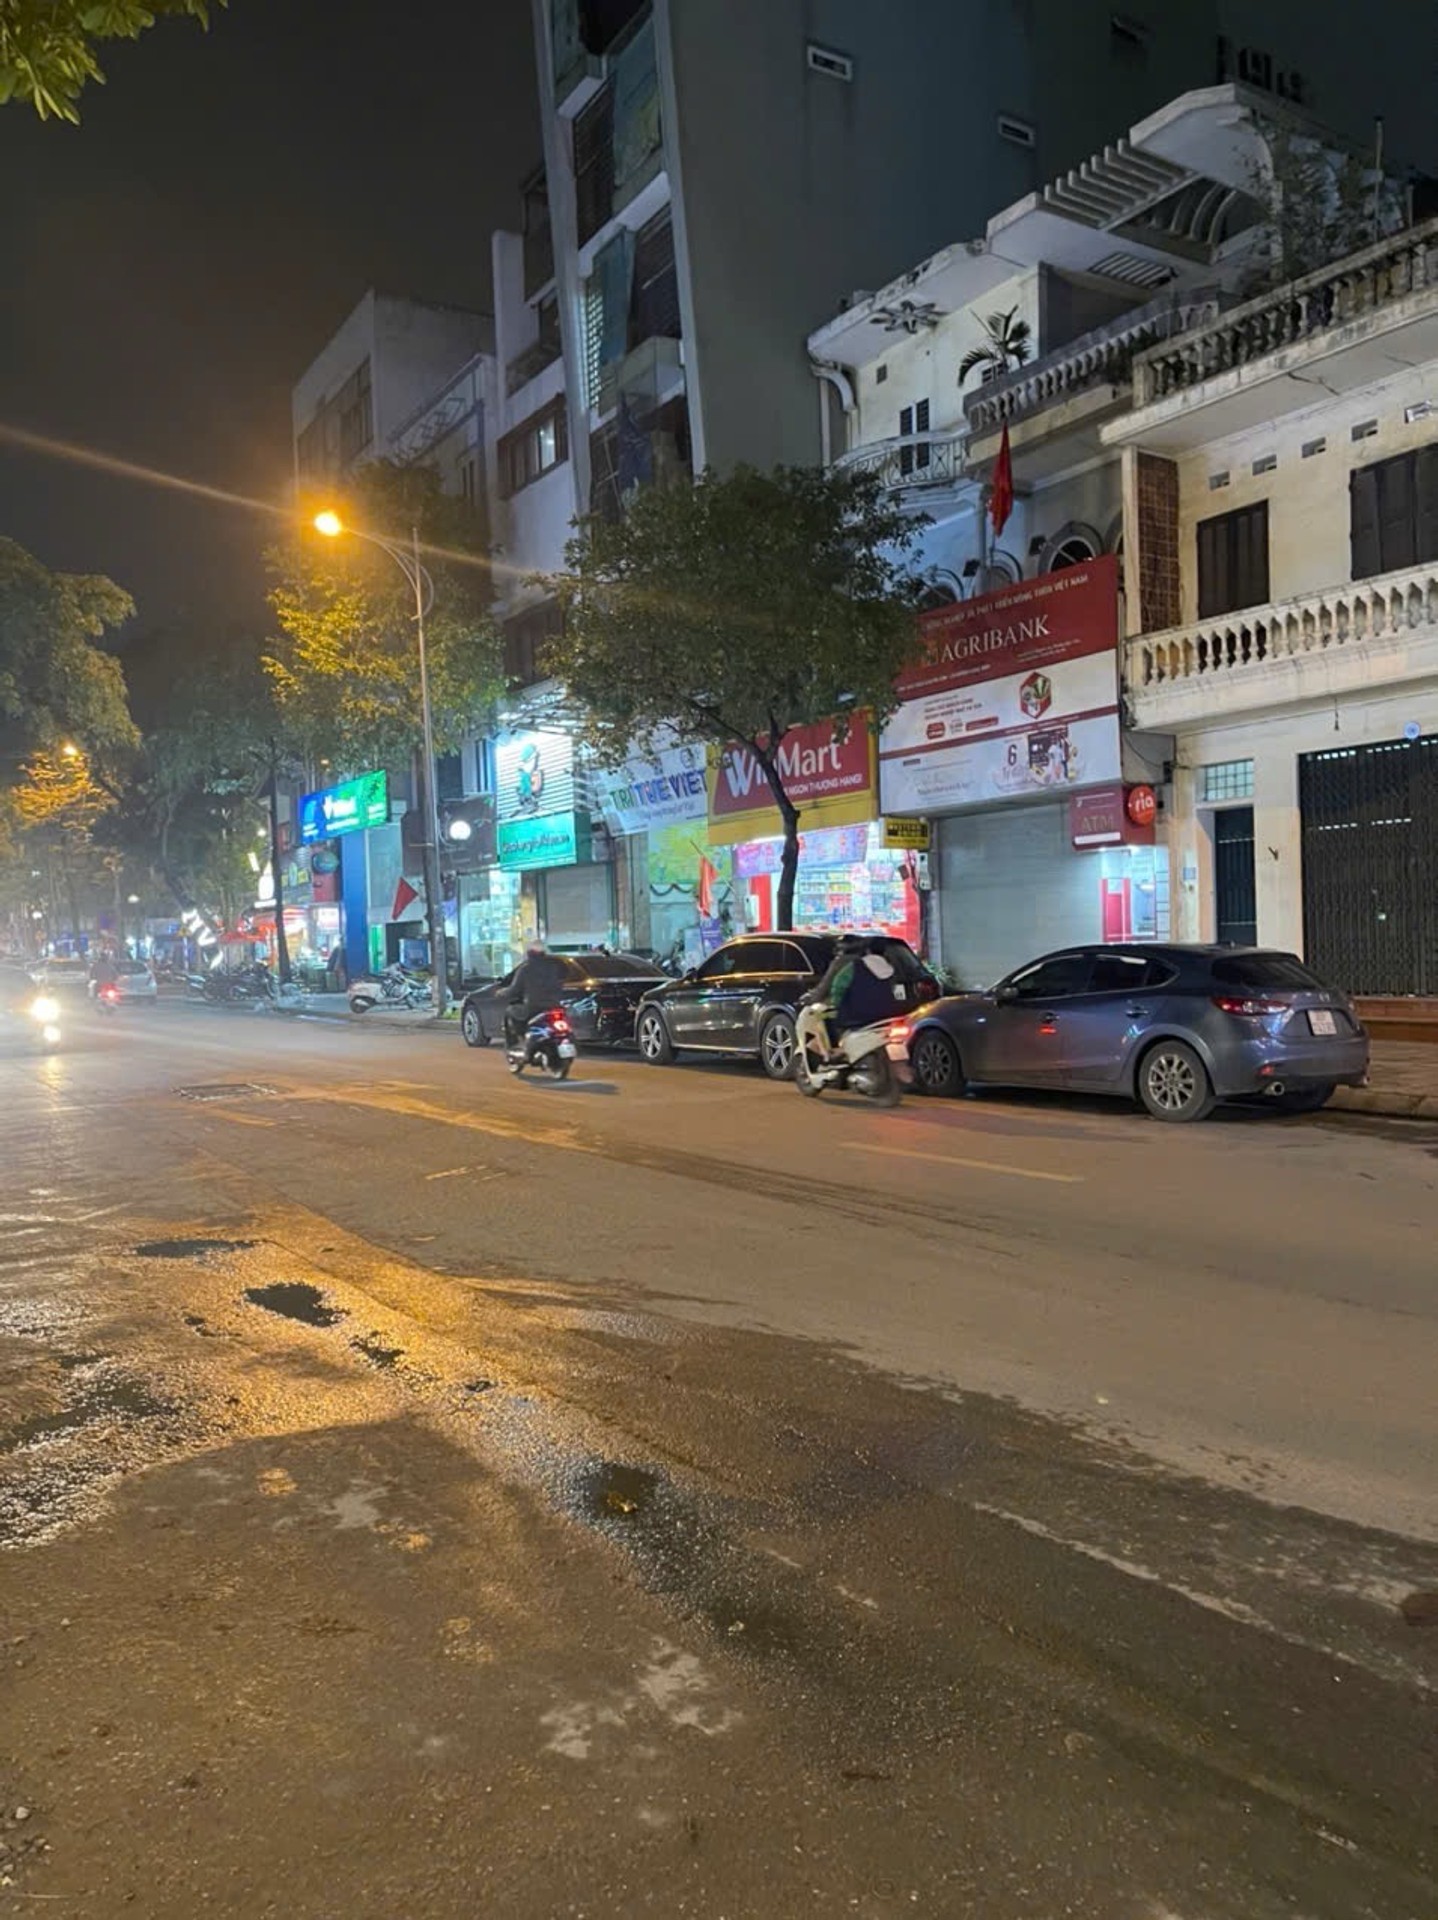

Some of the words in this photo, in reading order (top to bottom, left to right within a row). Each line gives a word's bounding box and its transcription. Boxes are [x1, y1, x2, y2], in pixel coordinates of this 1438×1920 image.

[941, 614, 1050, 663] AGRIBANK
[1007, 744, 1018, 766] 6
[1135, 792, 1154, 812] ria
[1082, 814, 1114, 833] ATM
